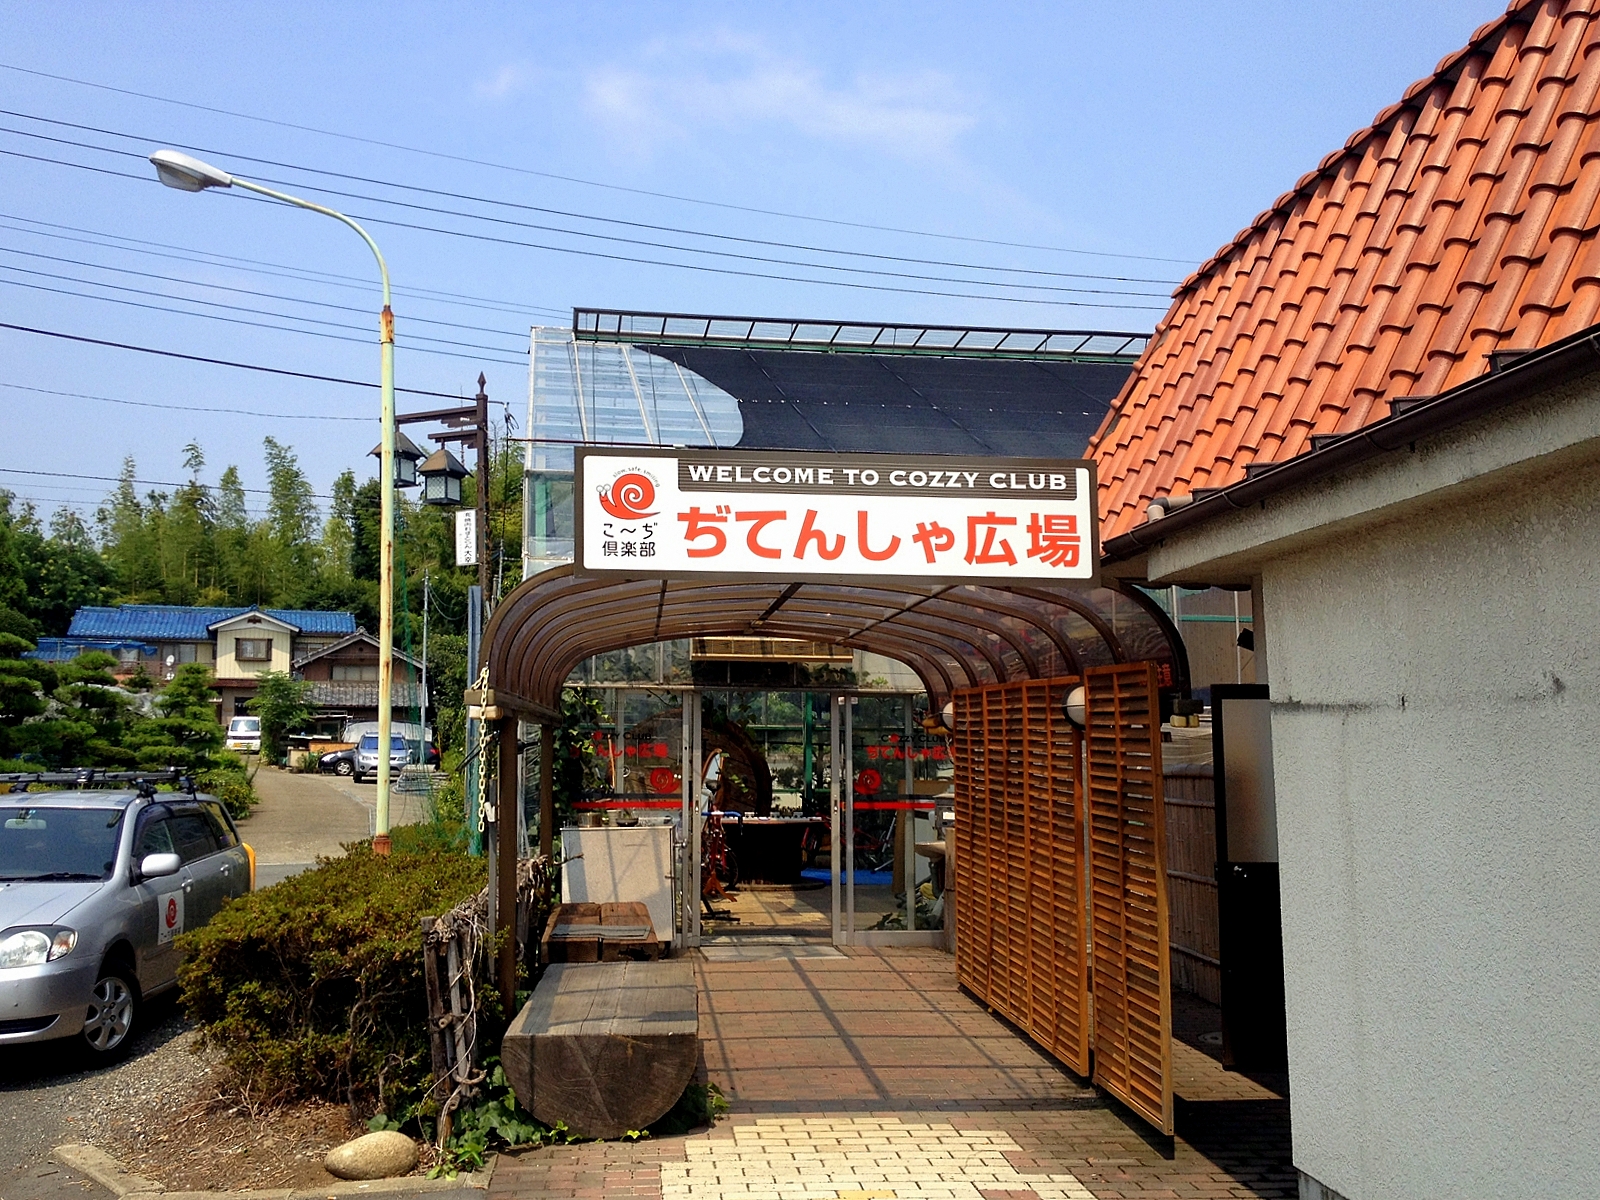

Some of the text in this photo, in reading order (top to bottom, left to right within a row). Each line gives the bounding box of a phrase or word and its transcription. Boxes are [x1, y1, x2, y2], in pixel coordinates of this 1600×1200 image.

[688, 465, 1067, 490] WELCOME TO COZZY CLUB
[677, 505, 1081, 568] ぢてんしゃ広場
[602, 540, 656, 557] 倶楽部
[623, 731, 652, 740] CLUB
